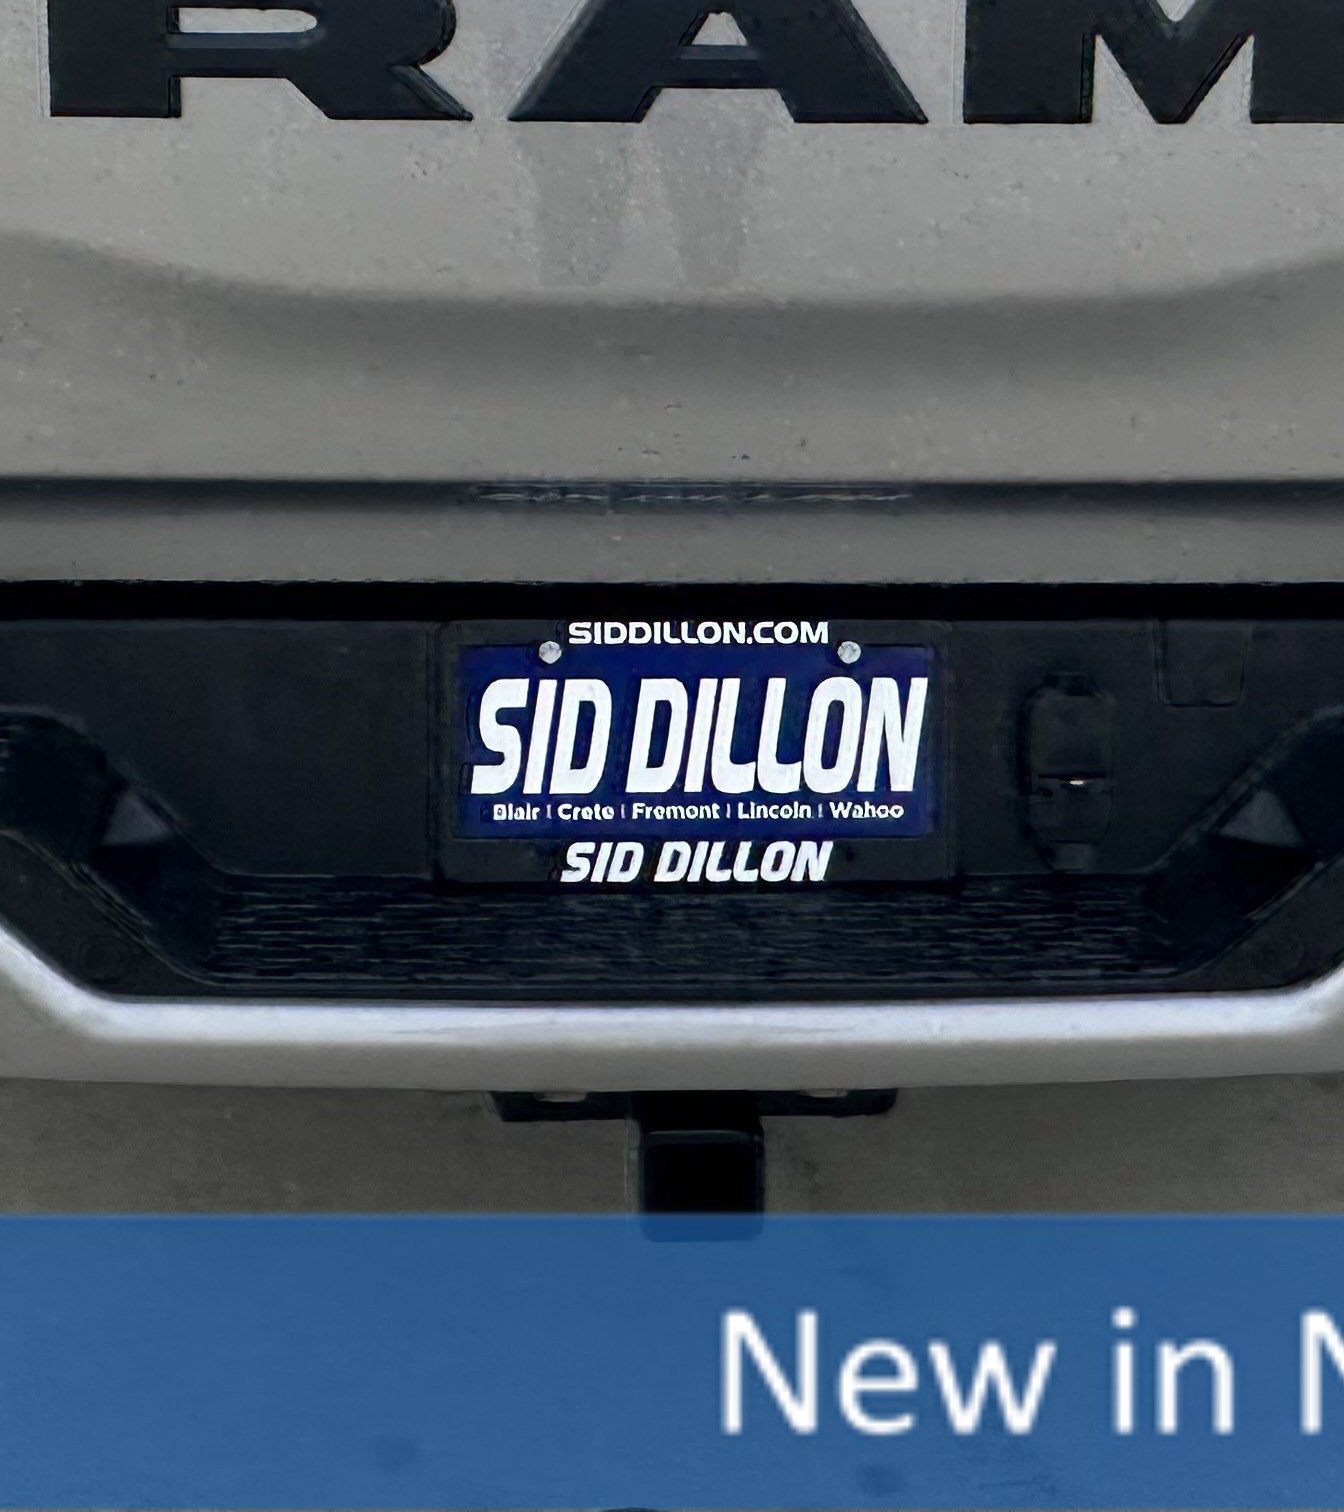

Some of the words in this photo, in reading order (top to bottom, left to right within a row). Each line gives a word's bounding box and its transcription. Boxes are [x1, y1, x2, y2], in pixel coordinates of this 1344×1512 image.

[568, 621, 829, 644] SIDDILLON.COM
[470, 678, 612, 794] SID
[625, 677, 929, 794] DILLON
[493, 803, 541, 821] Blair
[557, 803, 614, 821] Crete
[632, 802, 720, 820] Fremont
[737, 801, 813, 820] Lincoln
[828, 801, 905, 820] Wahoo
[560, 841, 644, 882] SID
[654, 840, 834, 882] DILLON
